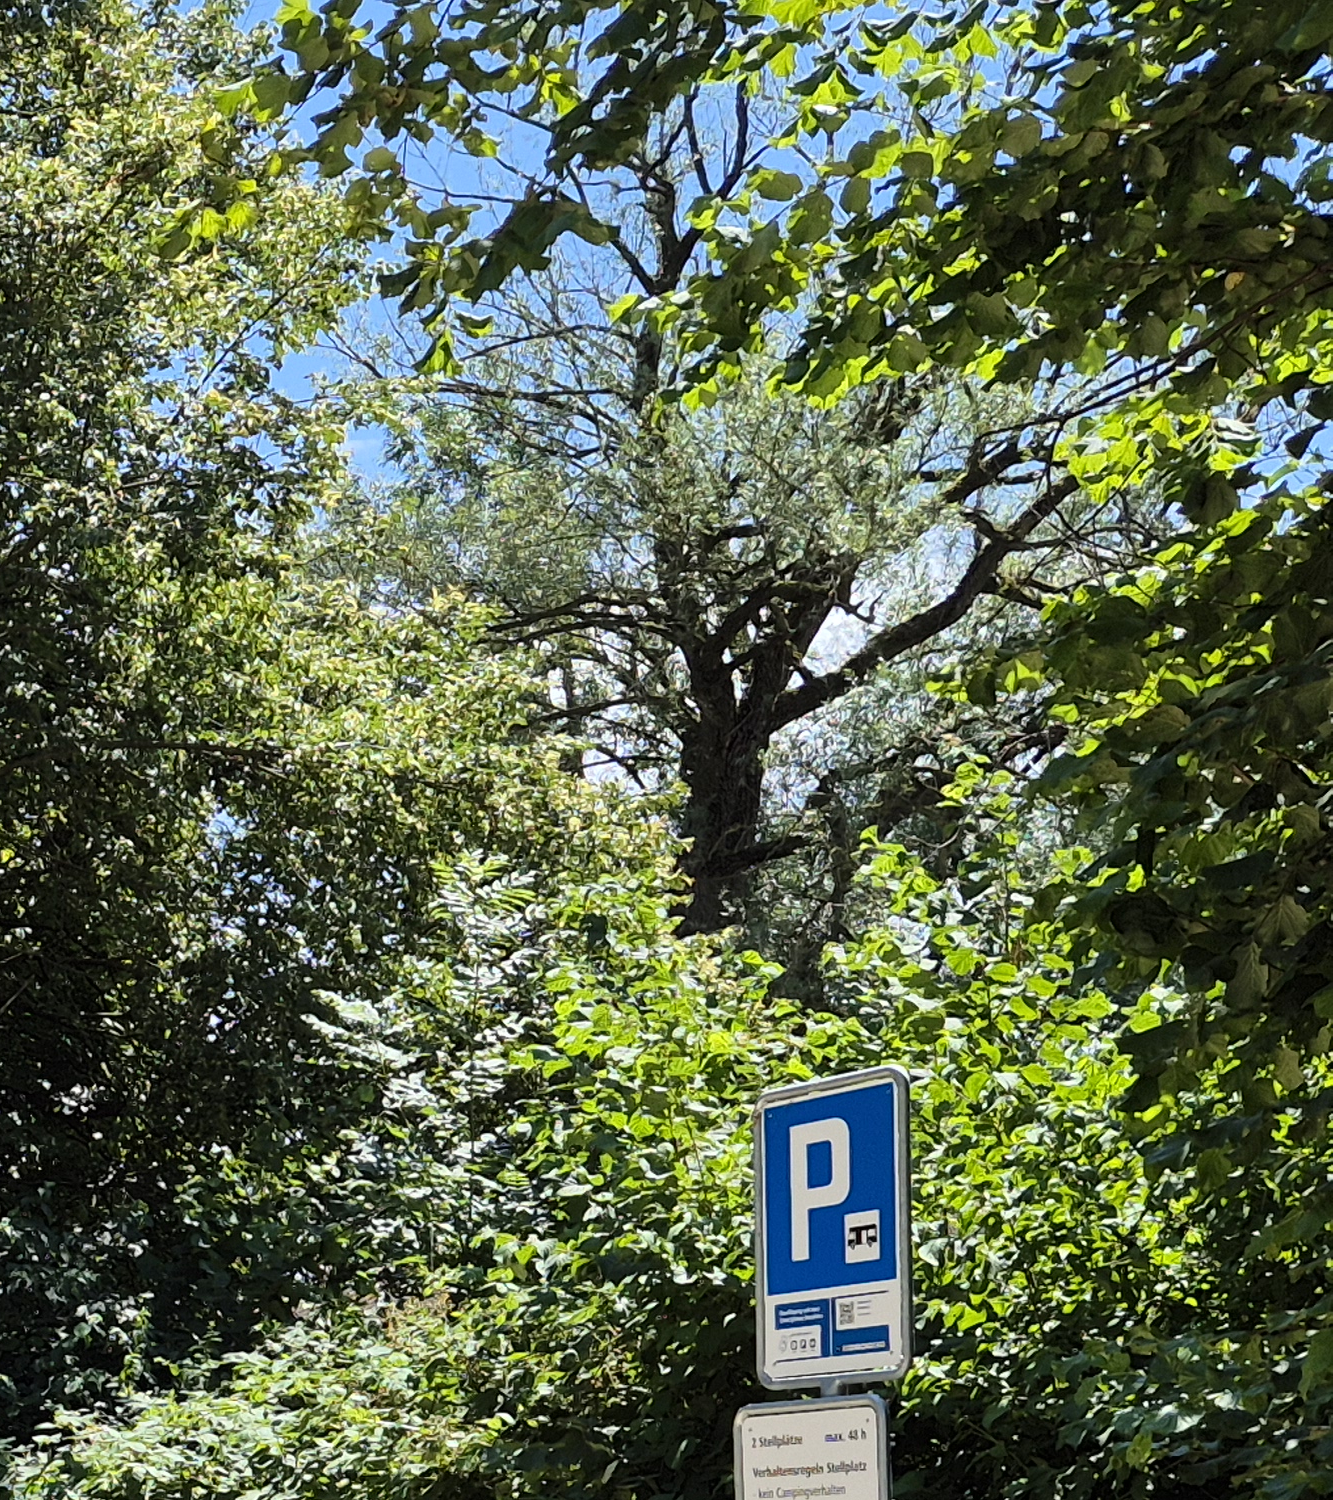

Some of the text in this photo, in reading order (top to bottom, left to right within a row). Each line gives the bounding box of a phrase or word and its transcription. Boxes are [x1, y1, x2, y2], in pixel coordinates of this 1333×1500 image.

[789, 1117, 850, 1263] P
[752, 1437, 757, 1448] 2
[759, 1435, 803, 1449] Stellplätze
[861, 1428, 867, 1440] h
[753, 1460, 867, 1478] Verhaltensregeln Stellplatz
[759, 1484, 846, 1500] kein Campingverhalten
